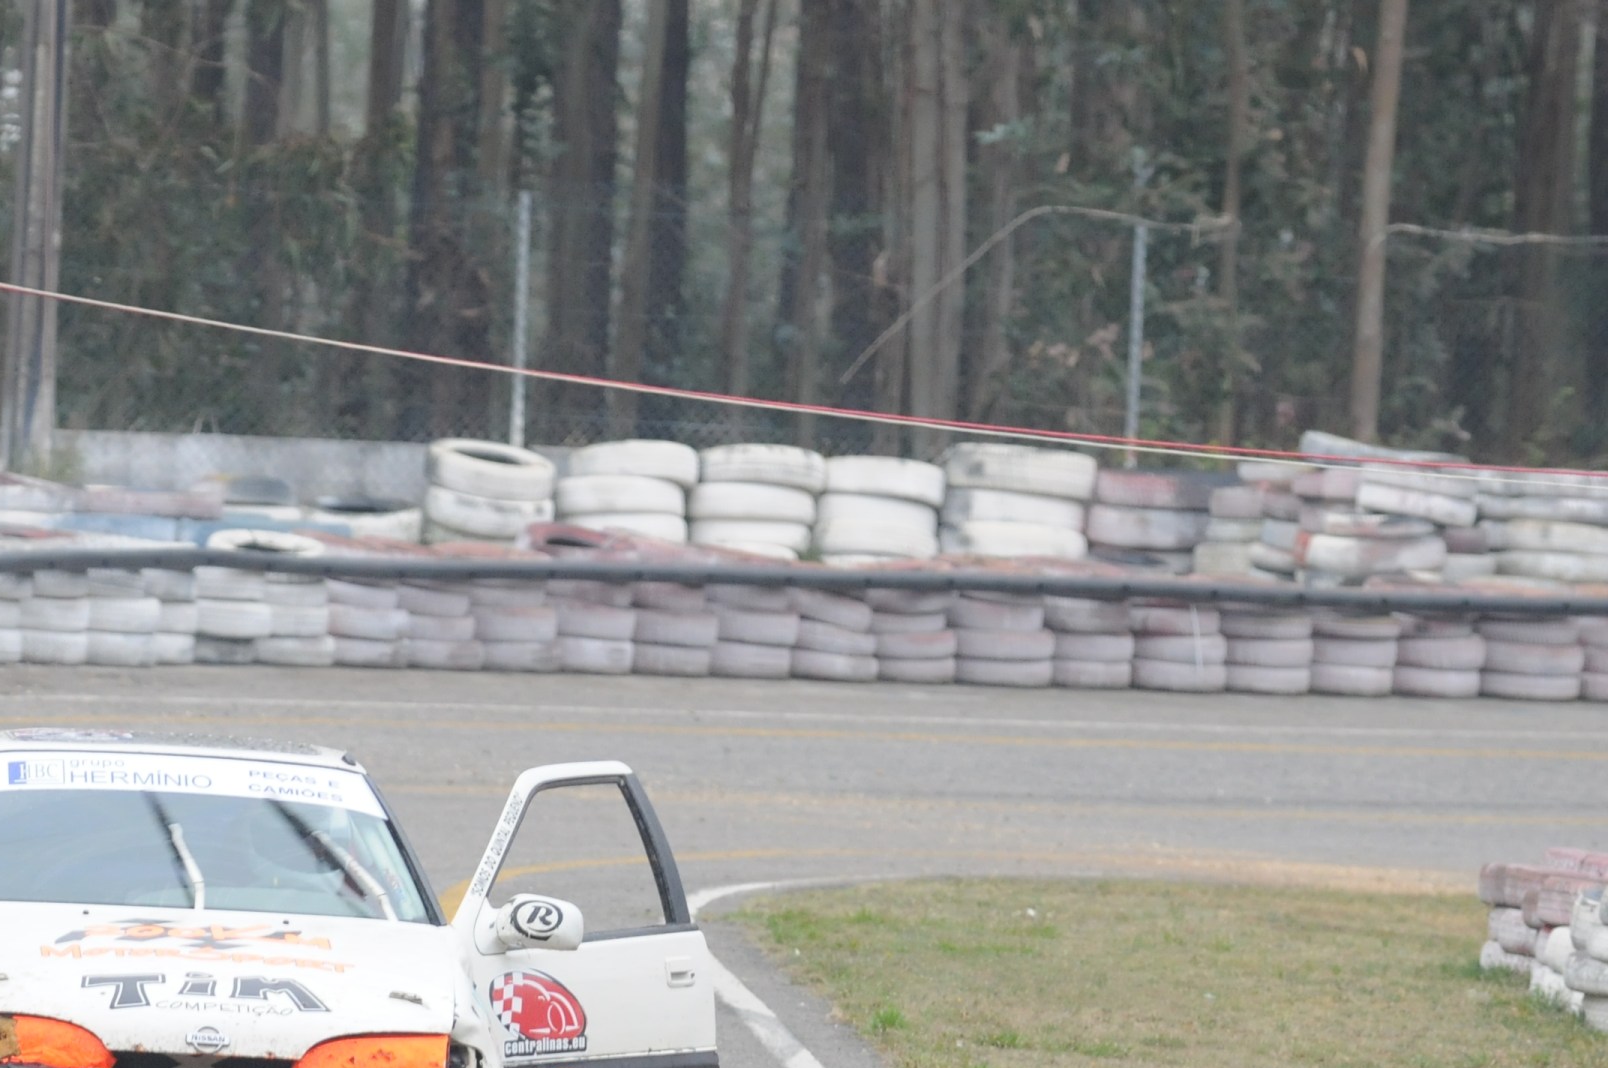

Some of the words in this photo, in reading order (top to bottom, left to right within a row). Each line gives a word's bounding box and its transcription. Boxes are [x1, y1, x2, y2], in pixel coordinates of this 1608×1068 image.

[69, 759, 125, 768] grupo
[70, 769, 212, 788] HERMÍNIO
[526, 905, 554, 925] R
[155, 999, 294, 1016] COMPETIÇÃO
[191, 1034, 226, 1042] NISSAN
[505, 1036, 586, 1055] centralinas.eu
